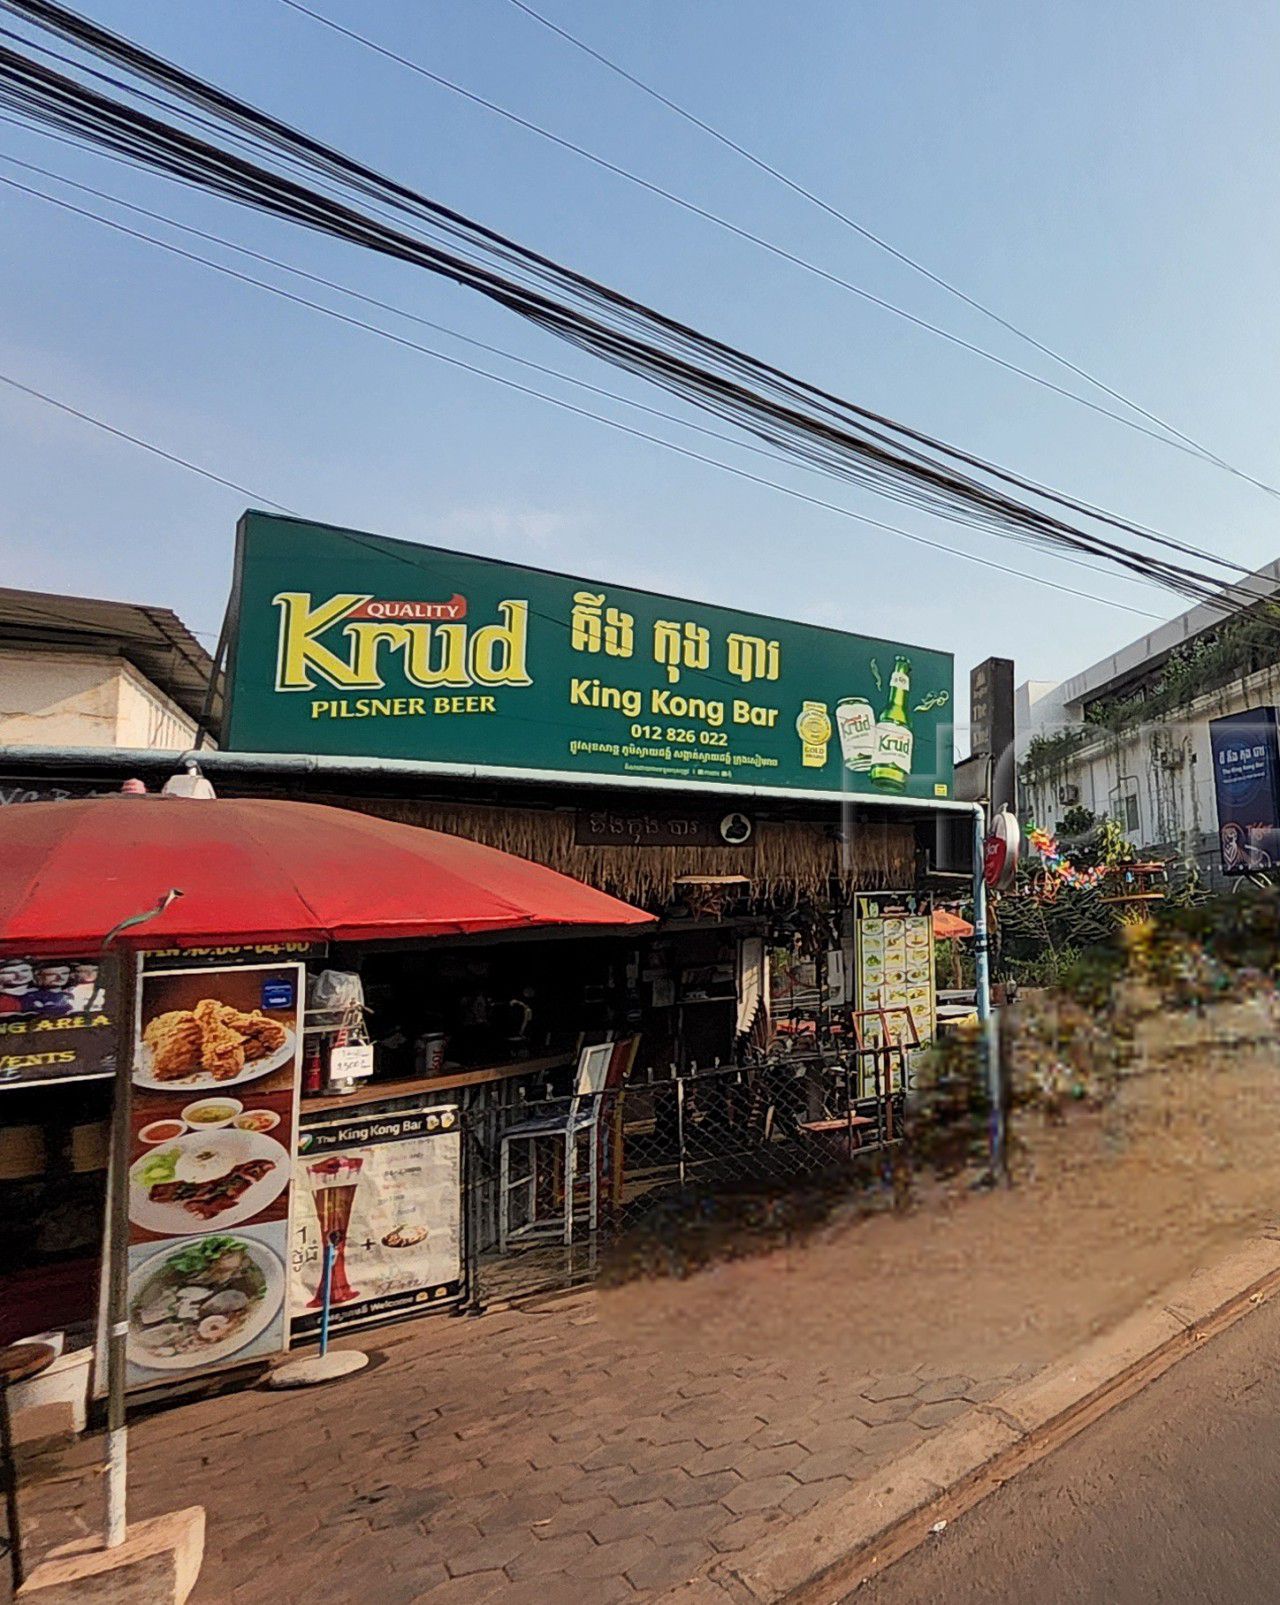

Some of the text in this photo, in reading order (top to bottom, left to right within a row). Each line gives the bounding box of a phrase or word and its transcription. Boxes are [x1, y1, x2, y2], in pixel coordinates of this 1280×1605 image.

[365, 601, 461, 619] QUALITY
[273, 592, 534, 689] Krud
[654, 620, 710, 683] កុង
[727, 632, 780, 682] បារ
[311, 695, 496, 719] PILSNER BEER
[570, 678, 642, 718] King
[650, 689, 726, 727] Kong
[732, 703, 779, 728] Bar
[631, 723, 729, 747] 012 826 022
[878, 733, 910, 755] Krud
[34, 1015, 111, 1031] AREA
[316, 1119, 423, 1145] The King Kong Bar
